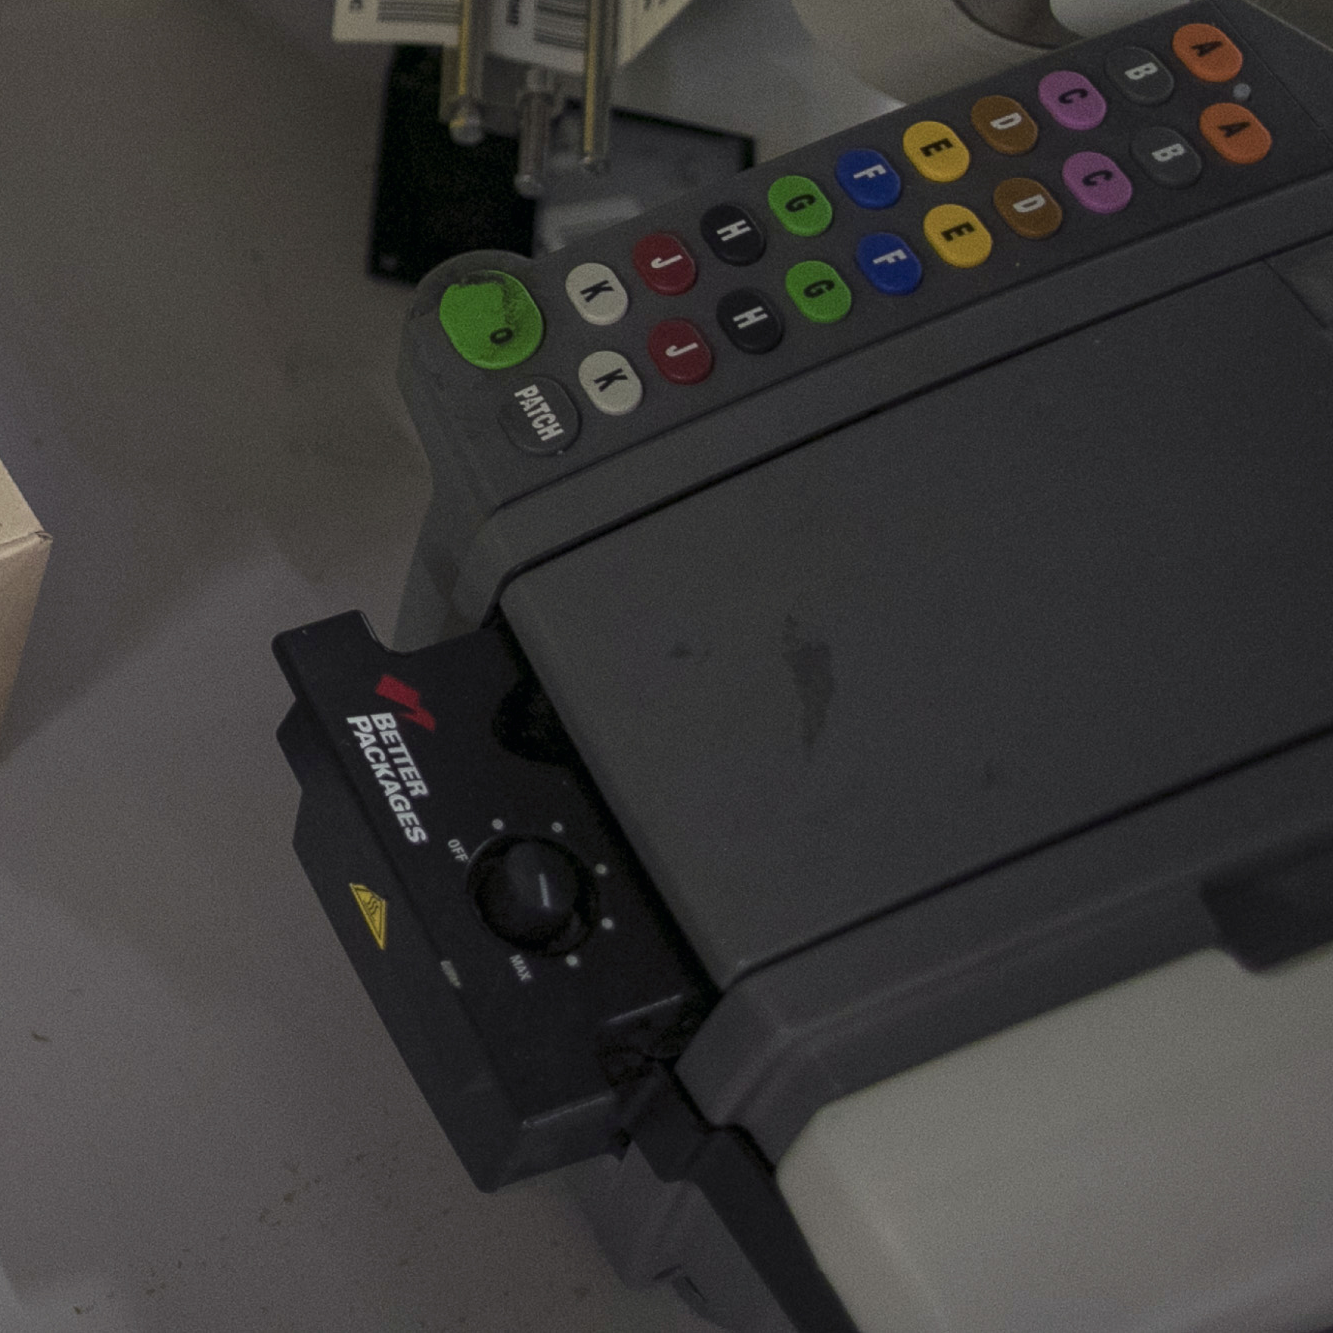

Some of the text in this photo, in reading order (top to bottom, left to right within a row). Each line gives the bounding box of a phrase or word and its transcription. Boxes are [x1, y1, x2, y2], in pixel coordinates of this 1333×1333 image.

[1191, 40, 1223, 57] A
[1124, 62, 1158, 80] B
[1058, 87, 1088, 104] C
[990, 112, 1023, 130] D
[1218, 121, 1251, 138] A
[920, 137, 953, 157] E
[1151, 143, 1185, 162] B
[853, 164, 886, 179] F
[1082, 169, 1113, 187] C
[786, 194, 816, 213] G
[1012, 194, 1046, 213] D
[717, 219, 751, 241] H
[941, 221, 975, 242] E
[651, 254, 683, 269] J
[873, 248, 907, 265] F
[580, 280, 614, 303] K
[804, 279, 834, 299] G
[733, 306, 768, 329] H
[665, 342, 698, 358] J
[593, 368, 628, 393] K
[514, 384, 564, 442] PATCH
[370, 712, 428, 797] BETTER
[346, 715, 427, 844] PACKAGES
[447, 838, 469, 863] OFF
[509, 953, 532, 982] MAX
